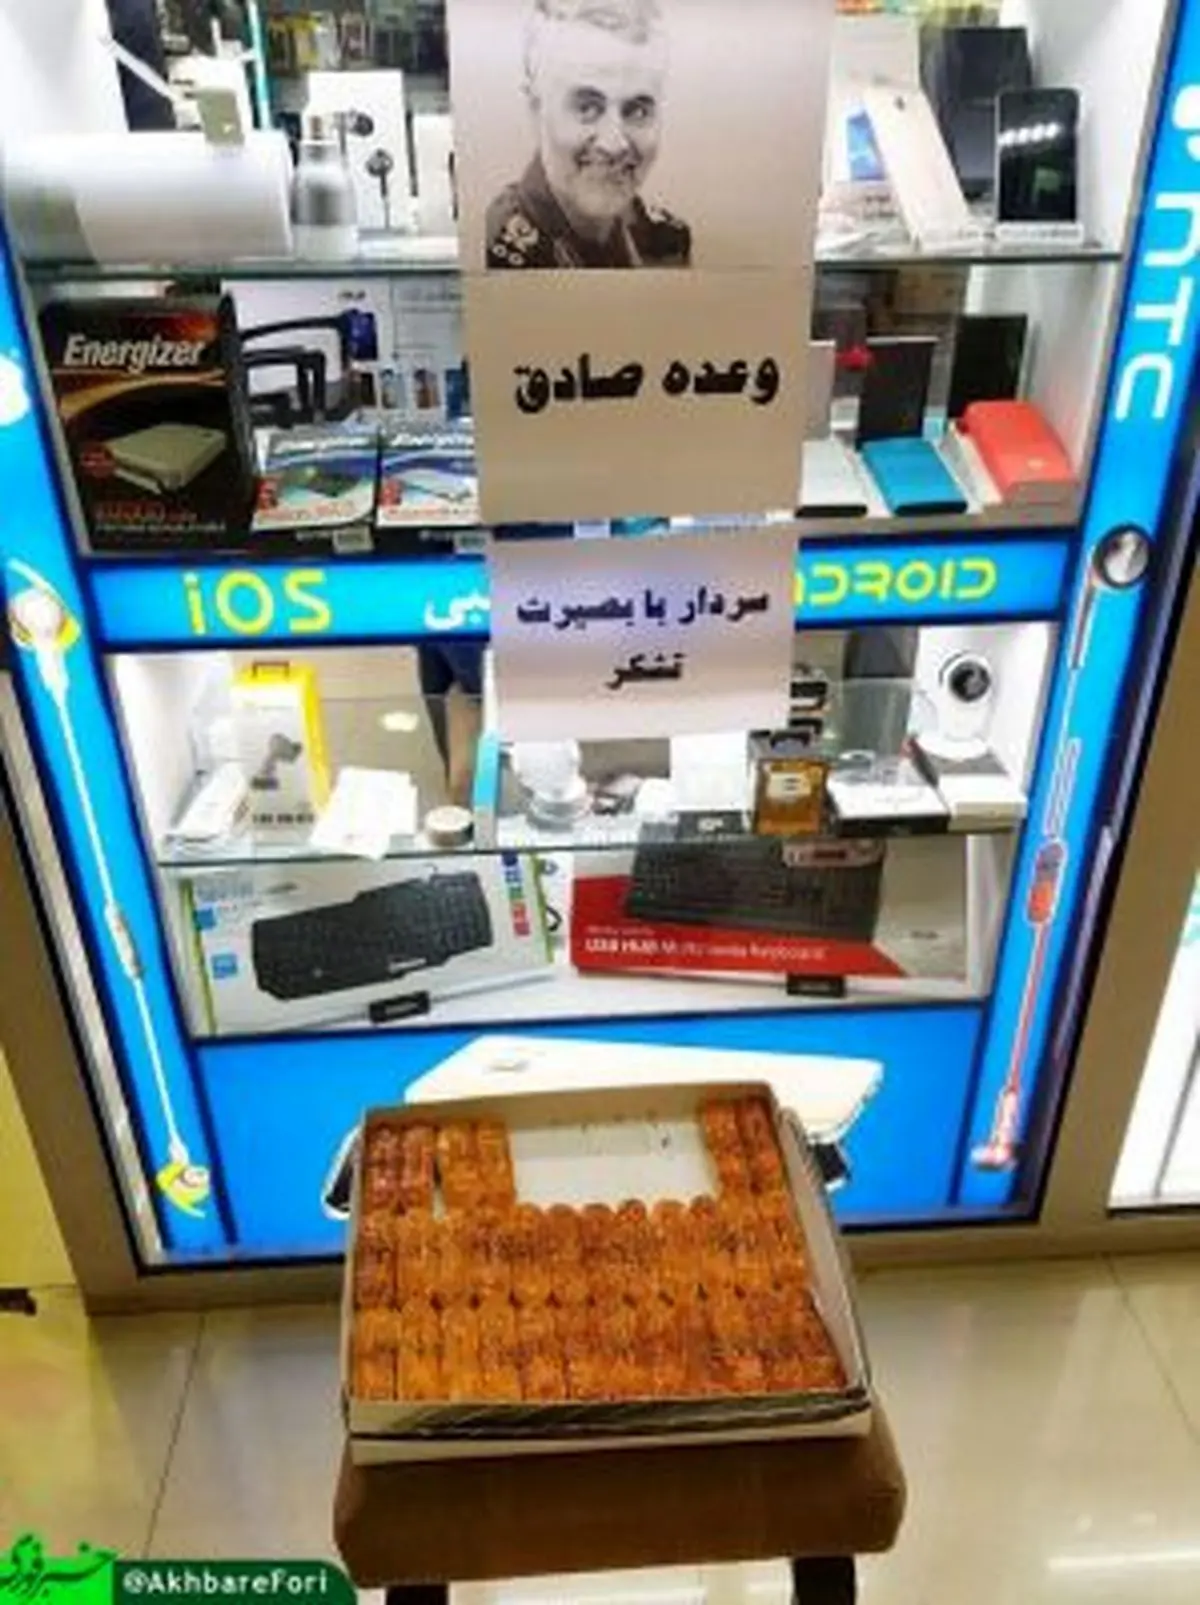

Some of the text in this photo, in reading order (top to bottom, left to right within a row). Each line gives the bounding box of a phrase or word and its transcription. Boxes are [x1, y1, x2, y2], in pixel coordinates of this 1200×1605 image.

[63, 333, 206, 375] Energizer
[514, 353, 780, 413] وعده صادق
[183, 569, 333, 636] iOS
[516, 585, 770, 631] سردار با بصیرت
[605, 652, 686, 690] تشکر
